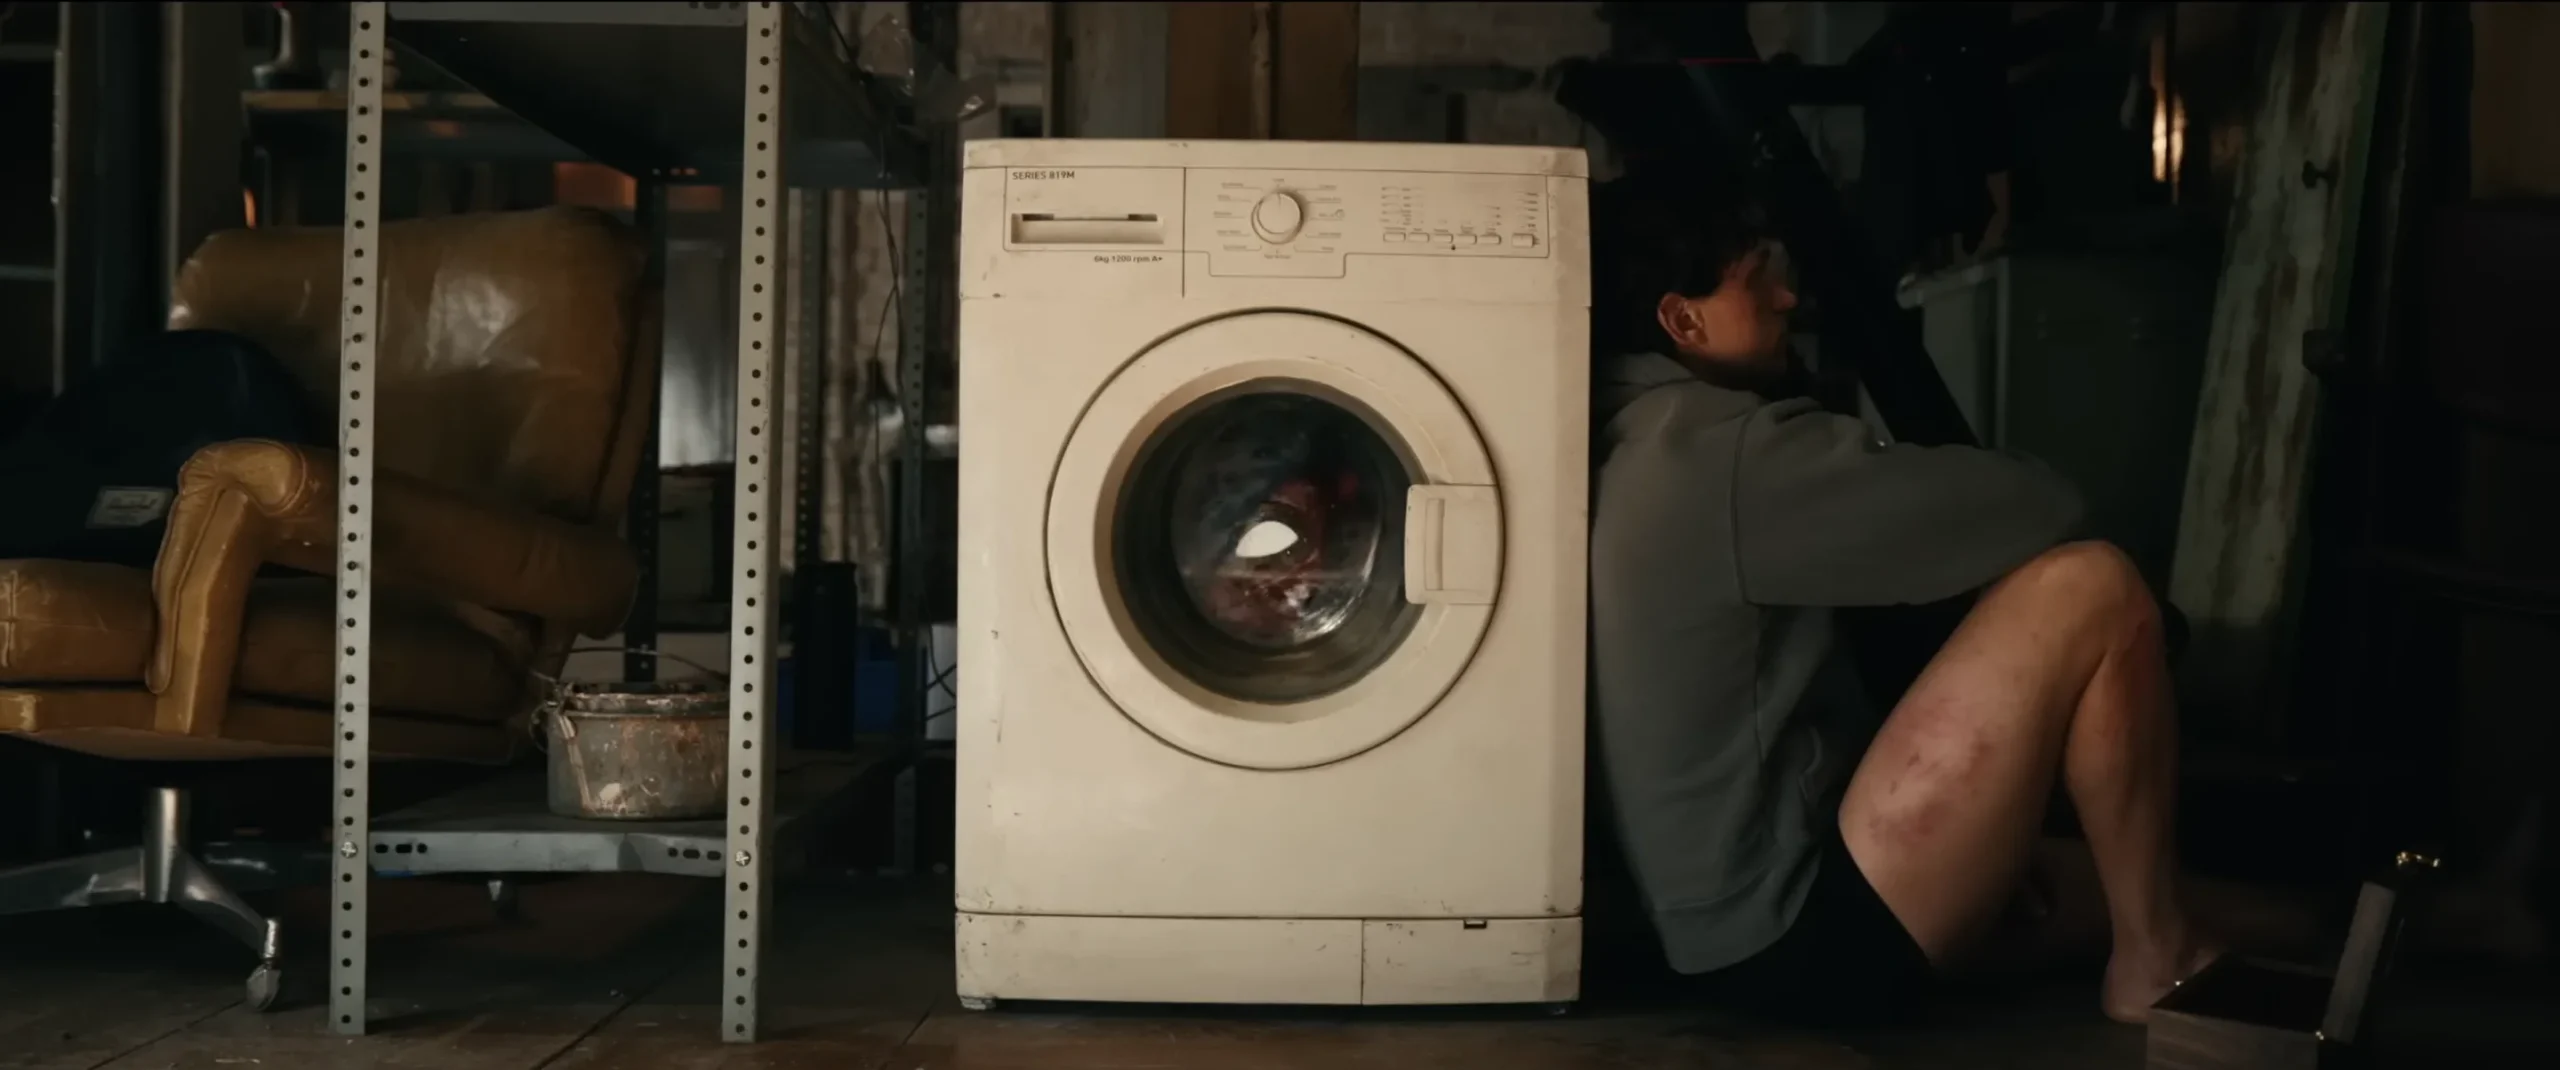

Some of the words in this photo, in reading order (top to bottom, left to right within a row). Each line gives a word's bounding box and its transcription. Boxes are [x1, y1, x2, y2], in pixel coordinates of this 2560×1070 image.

[1012, 171, 1047, 180] SERIES
[1049, 171, 1075, 179] 819M
[1094, 255, 1109, 264] 6kg
[1133, 256, 1150, 264] rpm
